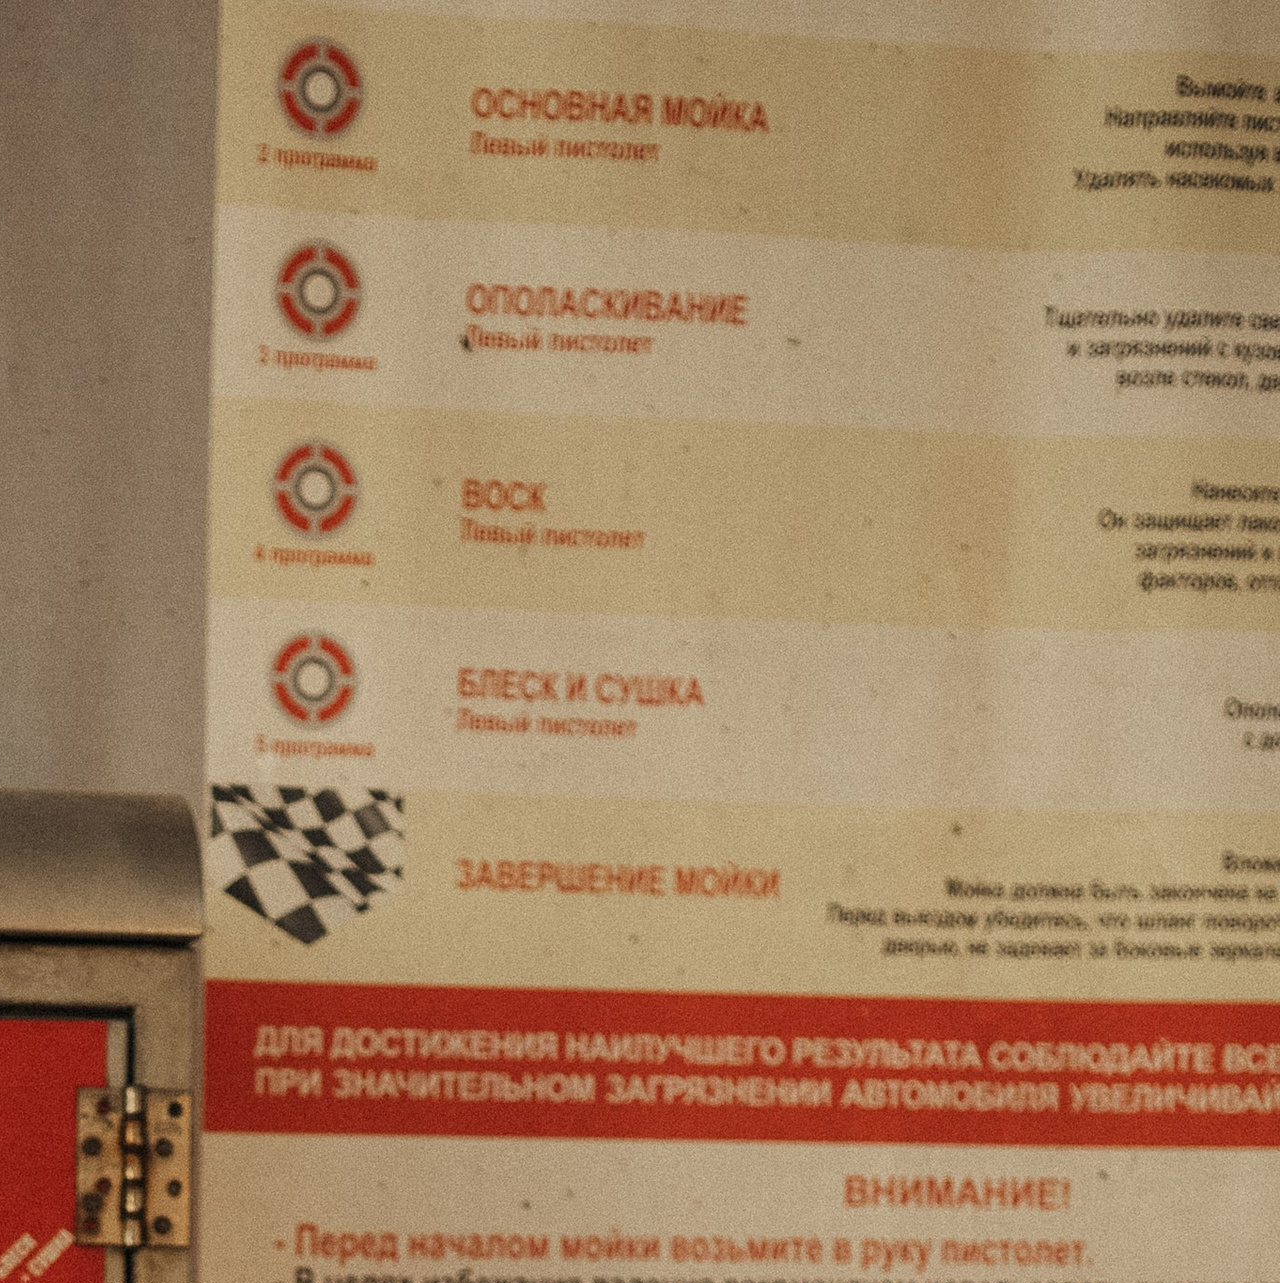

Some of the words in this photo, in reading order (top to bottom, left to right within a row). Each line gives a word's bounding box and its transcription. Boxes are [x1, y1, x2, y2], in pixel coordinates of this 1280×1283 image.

[471, 86, 653, 125] ОСНОВНАЯ
[660, 92, 770, 133] МОЙКА
[554, 136, 660, 163] пистолет
[466, 283, 749, 326] ОПОЛАСКИВАНИЕ
[550, 329, 653, 355] пистолет
[461, 478, 548, 515] ВОСК
[541, 524, 646, 552] пистолет
[457, 666, 558, 704] БЛЕСК
[566, 669, 588, 703] И
[594, 672, 705, 707] СУШКА
[538, 712, 638, 739] пистолет
[455, 858, 666, 897] ЗАВЕРШЕНИЕ
[673, 860, 781, 900] МОЙКИ
[253, 1025, 322, 1060] ДЛЯ
[330, 1026, 559, 1062] ДОСТИЖЕНИЯ
[565, 1032, 786, 1066] НАИЛУЧШЕГО
[792, 1036, 983, 1070] РЕЗУЛЬТАТА
[988, 1036, 1215, 1075] СОБЛЮДАЙТЕ
[253, 1067, 321, 1097] ПРИ
[331, 1069, 596, 1102] ЗНАЧИТЕЛЬНОМ
[605, 1074, 833, 1107] ЗАГРЯЗНЕНИИ
[840, 1079, 1060, 1113] АВТОМОБИЛЯ
[844, 1174, 1071, 1212] ВНИМАНИЕ!
[294, 1222, 399, 1264] Перед
[408, 1232, 549, 1260] началом
[561, 1229, 660, 1262] мойки
[670, 1236, 825, 1264] возьмите
[833, 1239, 851, 1263] в
[860, 1239, 932, 1273] руку
